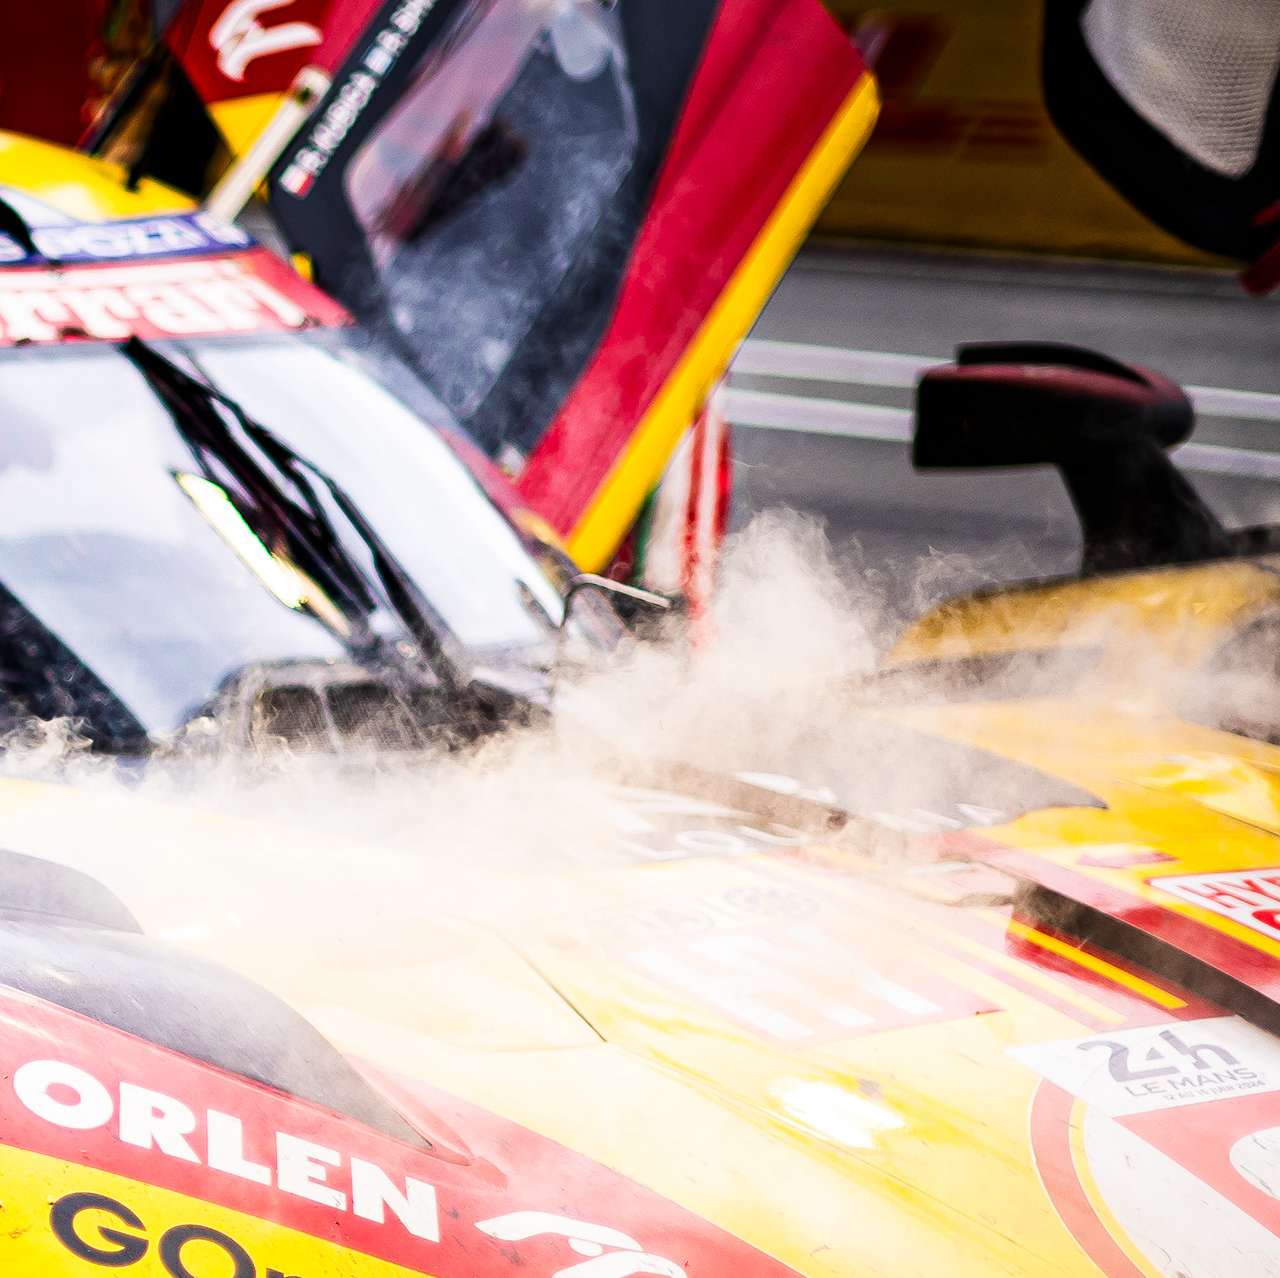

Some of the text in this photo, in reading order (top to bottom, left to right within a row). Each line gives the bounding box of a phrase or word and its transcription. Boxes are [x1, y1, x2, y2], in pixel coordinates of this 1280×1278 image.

[1076, 1029, 1240, 1083] 24h
[1124, 1067, 1259, 1097] LE MANS
[13, 1060, 440, 1243] ORLEN
